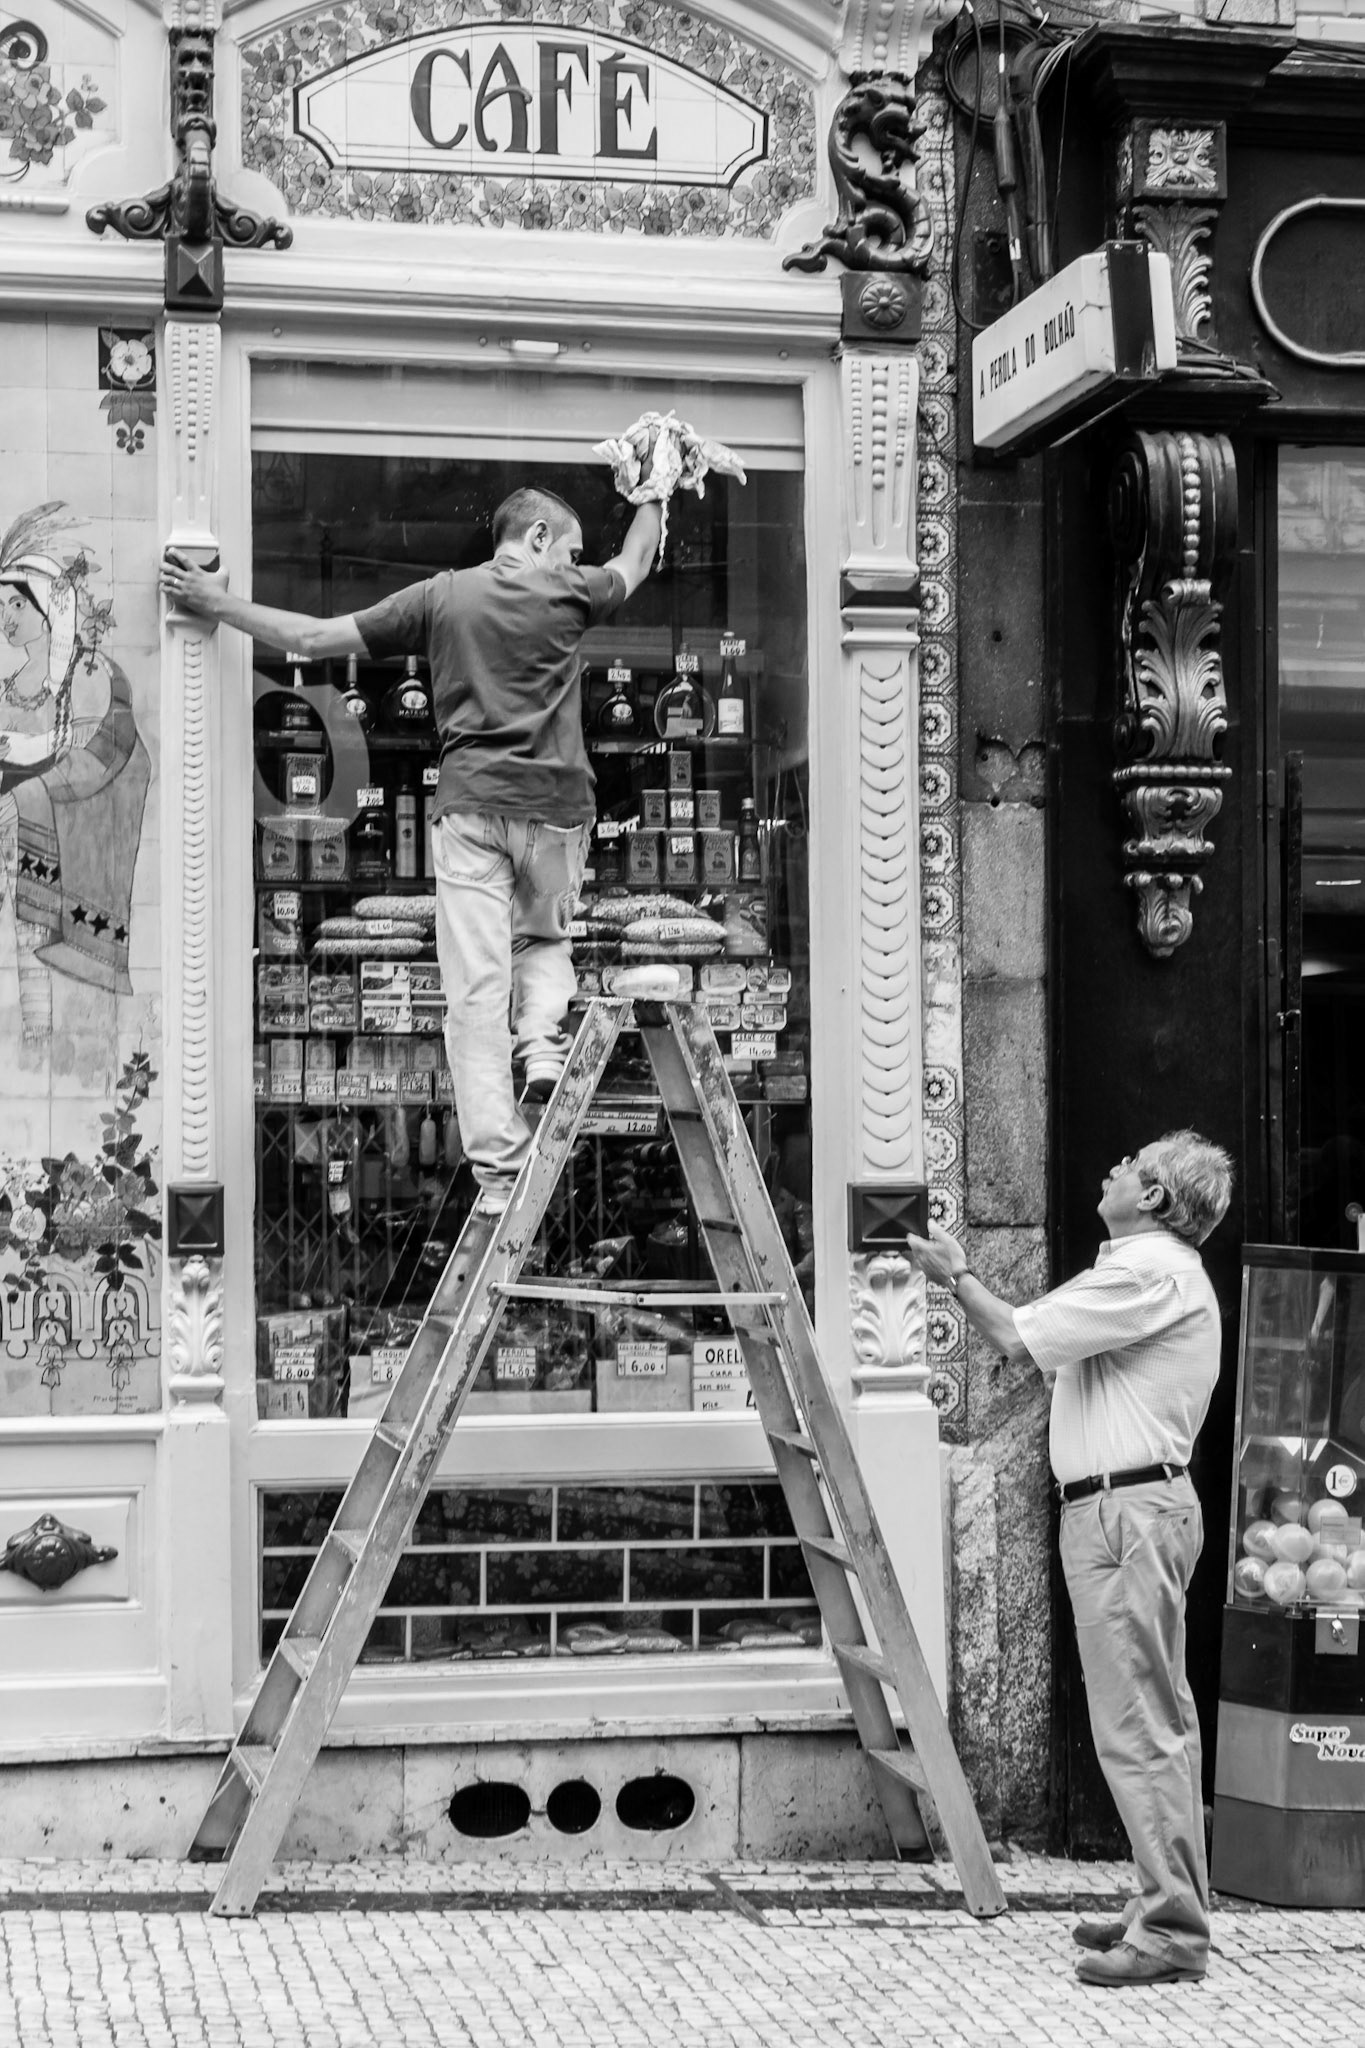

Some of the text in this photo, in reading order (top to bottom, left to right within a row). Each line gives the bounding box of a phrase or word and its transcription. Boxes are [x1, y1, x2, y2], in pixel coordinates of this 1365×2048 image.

[409, 41, 658, 161] CAFÉ
[980, 369, 985, 400] A
[990, 346, 1017, 392] PEROLA
[1025, 333, 1035, 368] DO
[399, 709, 429, 717] MATEUS
[705, 1348, 744, 1364] OREL
[286, 1367, 310, 1380] 8.00
[631, 1360, 656, 1372] 6.00
[1293, 1727, 1347, 1743] Super
